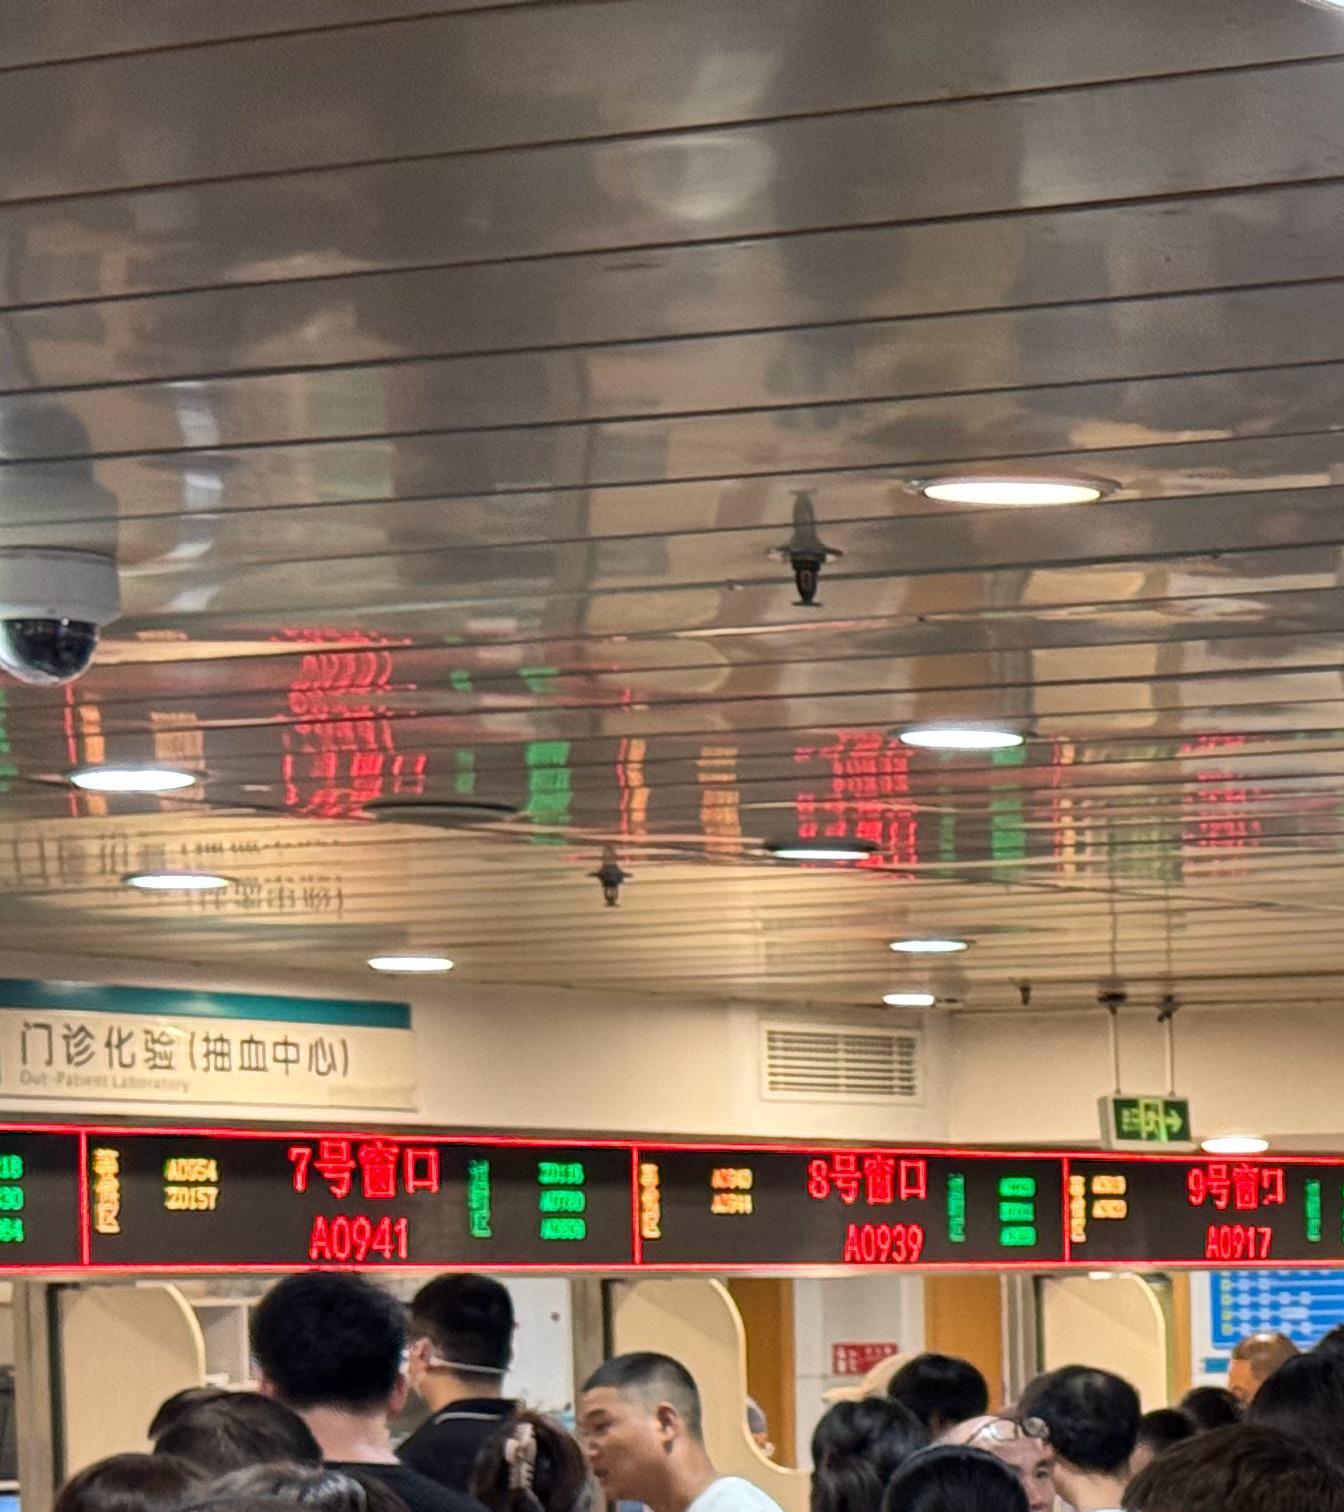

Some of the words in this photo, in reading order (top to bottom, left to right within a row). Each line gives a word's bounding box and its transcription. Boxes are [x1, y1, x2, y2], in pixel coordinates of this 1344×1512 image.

[20, 1021, 349, 1078] 门诊化验(抽血中心)
[288, 1139, 440, 1198] 7号窗口
[807, 1154, 927, 1205] 8号窗口
[309, 1215, 408, 1261] A0941
[844, 1223, 923, 1262] A0939
[1205, 1225, 1272, 1259] A0917
